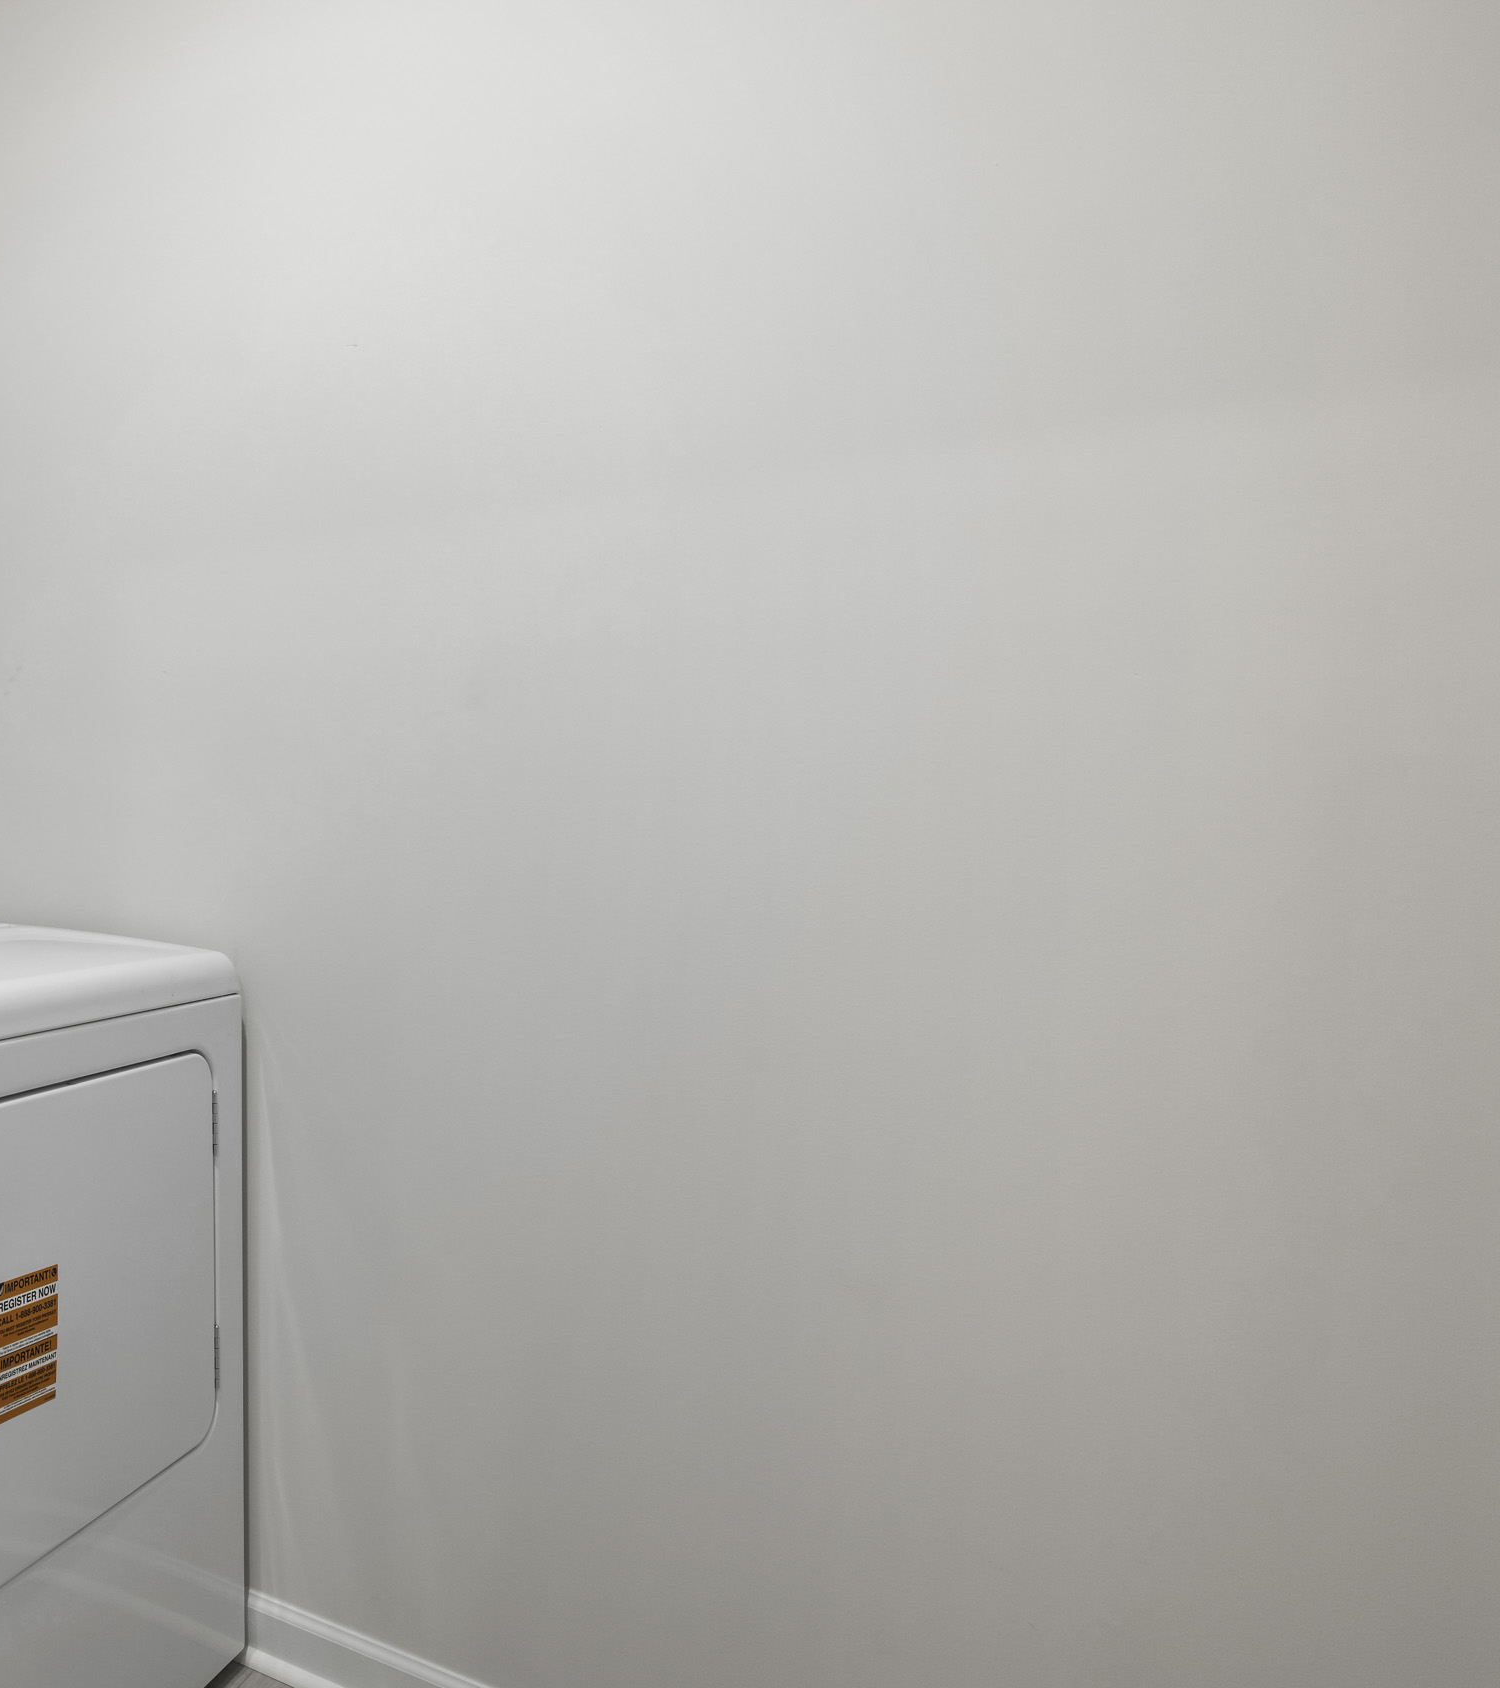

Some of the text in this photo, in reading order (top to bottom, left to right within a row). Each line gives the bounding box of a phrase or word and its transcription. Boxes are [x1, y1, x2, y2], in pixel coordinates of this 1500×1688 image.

[4, 1269, 51, 1294] IMPORTANT!
[38, 1283, 57, 1298] NOW
[0, 1340, 52, 1370] IMPORTANTE!
[28, 1352, 57, 1369] MAINTENANT
